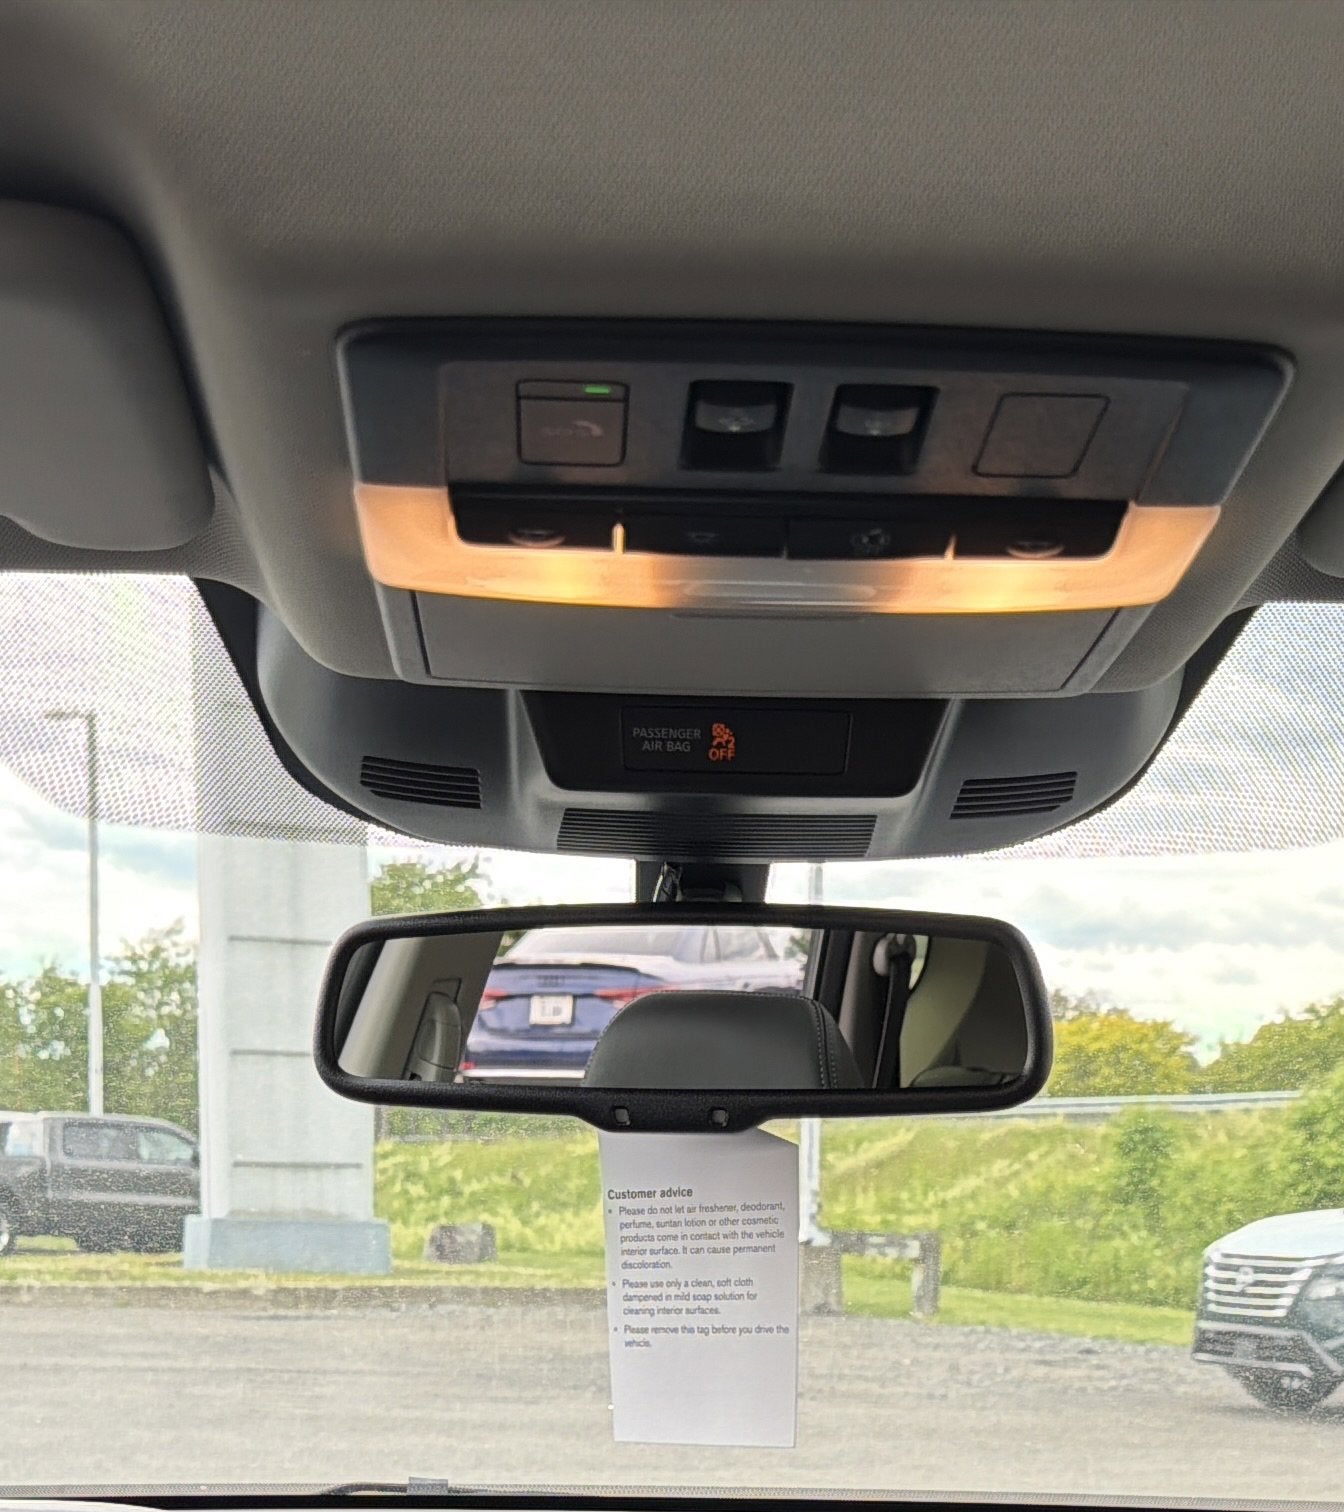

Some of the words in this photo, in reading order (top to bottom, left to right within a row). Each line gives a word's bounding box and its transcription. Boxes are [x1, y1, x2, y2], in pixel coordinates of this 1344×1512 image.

[632, 727, 702, 739] PASSENGER
[641, 740, 663, 752] AIR
[666, 740, 692, 752] BAG
[708, 748, 736, 761] OFF
[607, 1188, 657, 1200] Customer
[659, 1186, 693, 1198] advice
[618, 1205, 645, 1216] Please
[646, 1204, 658, 1215] do
[658, 1204, 673, 1214] not
[673, 1203, 685, 1214] let
[685, 1203, 697, 1214] air
[697, 1202, 740, 1213] freshener,
[739, 1200, 786, 1212] deodorant,
[619, 1218, 654, 1231] perfume,
[655, 1217, 682, 1228] suntan
[683, 1216, 706, 1227] lotion
[708, 1218, 716, 1226] or
[718, 1215, 739, 1226] other
[741, 1214, 779, 1225] cosmetic
[619, 1231, 655, 1245] products
[656, 1233, 679, 1241] come
[680, 1231, 688, 1241] in
[689, 1230, 720, 1240] contact
[721, 1229, 739, 1240] with
[740, 1229, 754, 1239] the
[754, 1228, 785, 1239] vehicle
[620, 1246, 647, 1256] interior
[648, 1245, 681, 1255] surface.
[681, 1245, 688, 1255] It
[705, 1246, 731, 1254] cause
[732, 1243, 776, 1256] permanent
[620, 1259, 673, 1269] discoloration.
